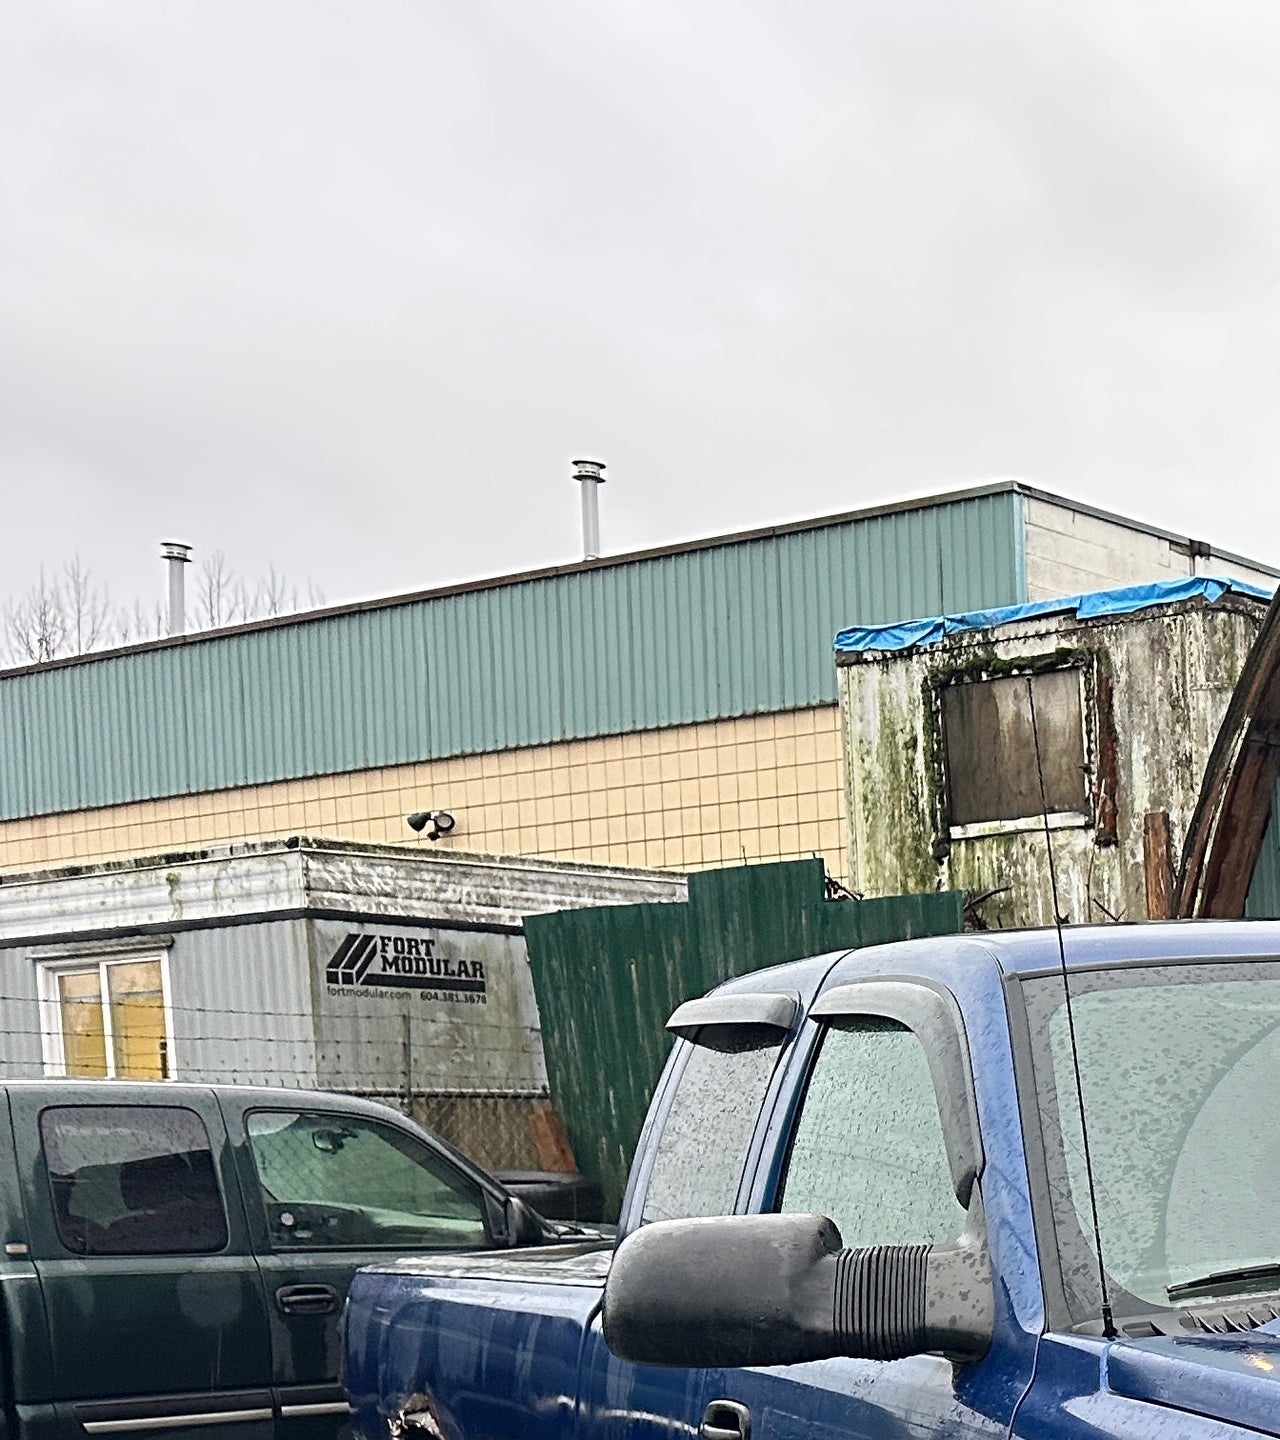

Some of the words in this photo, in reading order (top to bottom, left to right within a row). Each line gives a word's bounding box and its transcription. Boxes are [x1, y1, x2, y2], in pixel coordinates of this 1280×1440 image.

[379, 935, 435, 957] FORT
[381, 955, 485, 979] MODULAR
[326, 985, 412, 1000] fortmodular.com
